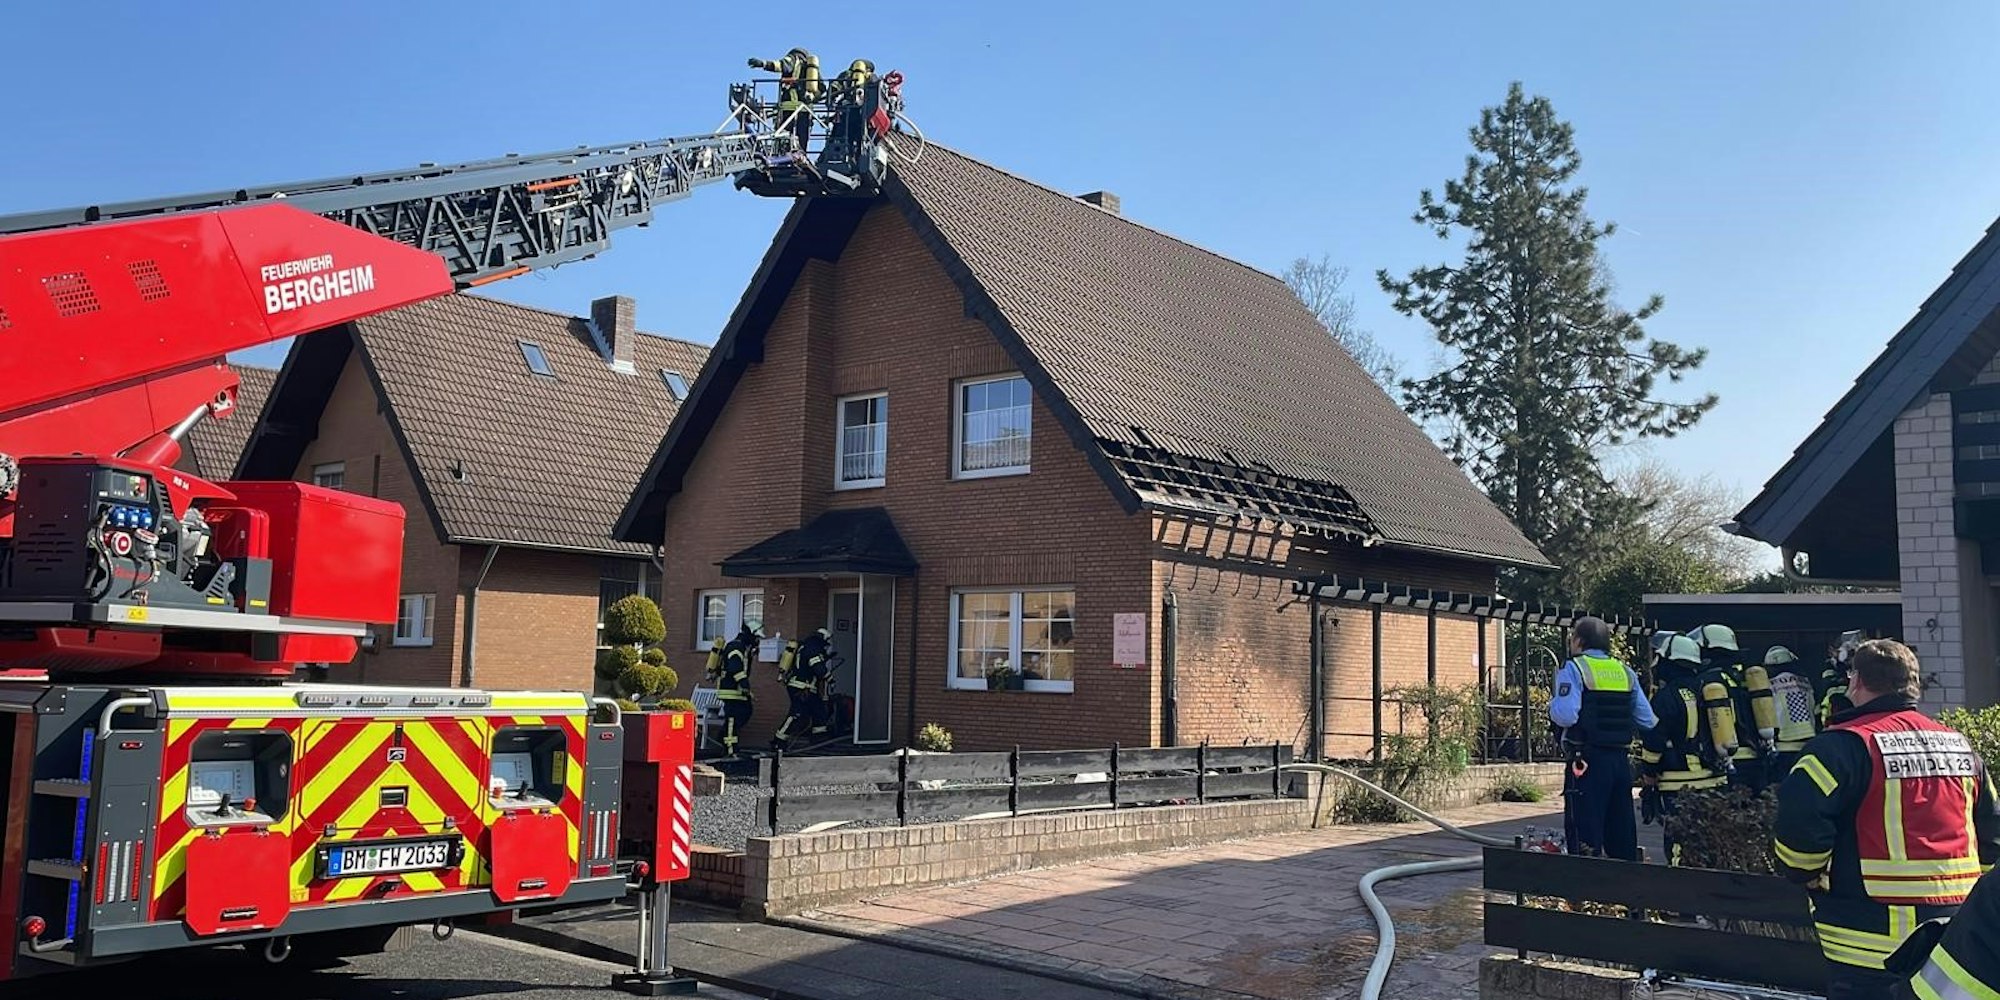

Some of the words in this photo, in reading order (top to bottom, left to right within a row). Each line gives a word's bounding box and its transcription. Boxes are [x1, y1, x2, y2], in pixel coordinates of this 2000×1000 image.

[261, 254, 334, 282] FEUERWEHR
[264, 264, 374, 315] BERGHEIM
[779, 594, 786, 606] 7
[1926, 618, 1937, 634] 9
[1956, 758, 1972, 771] 23
[343, 849, 367, 871] BM
[379, 847, 400, 868] FW
[404, 844, 447, 866] 2033
